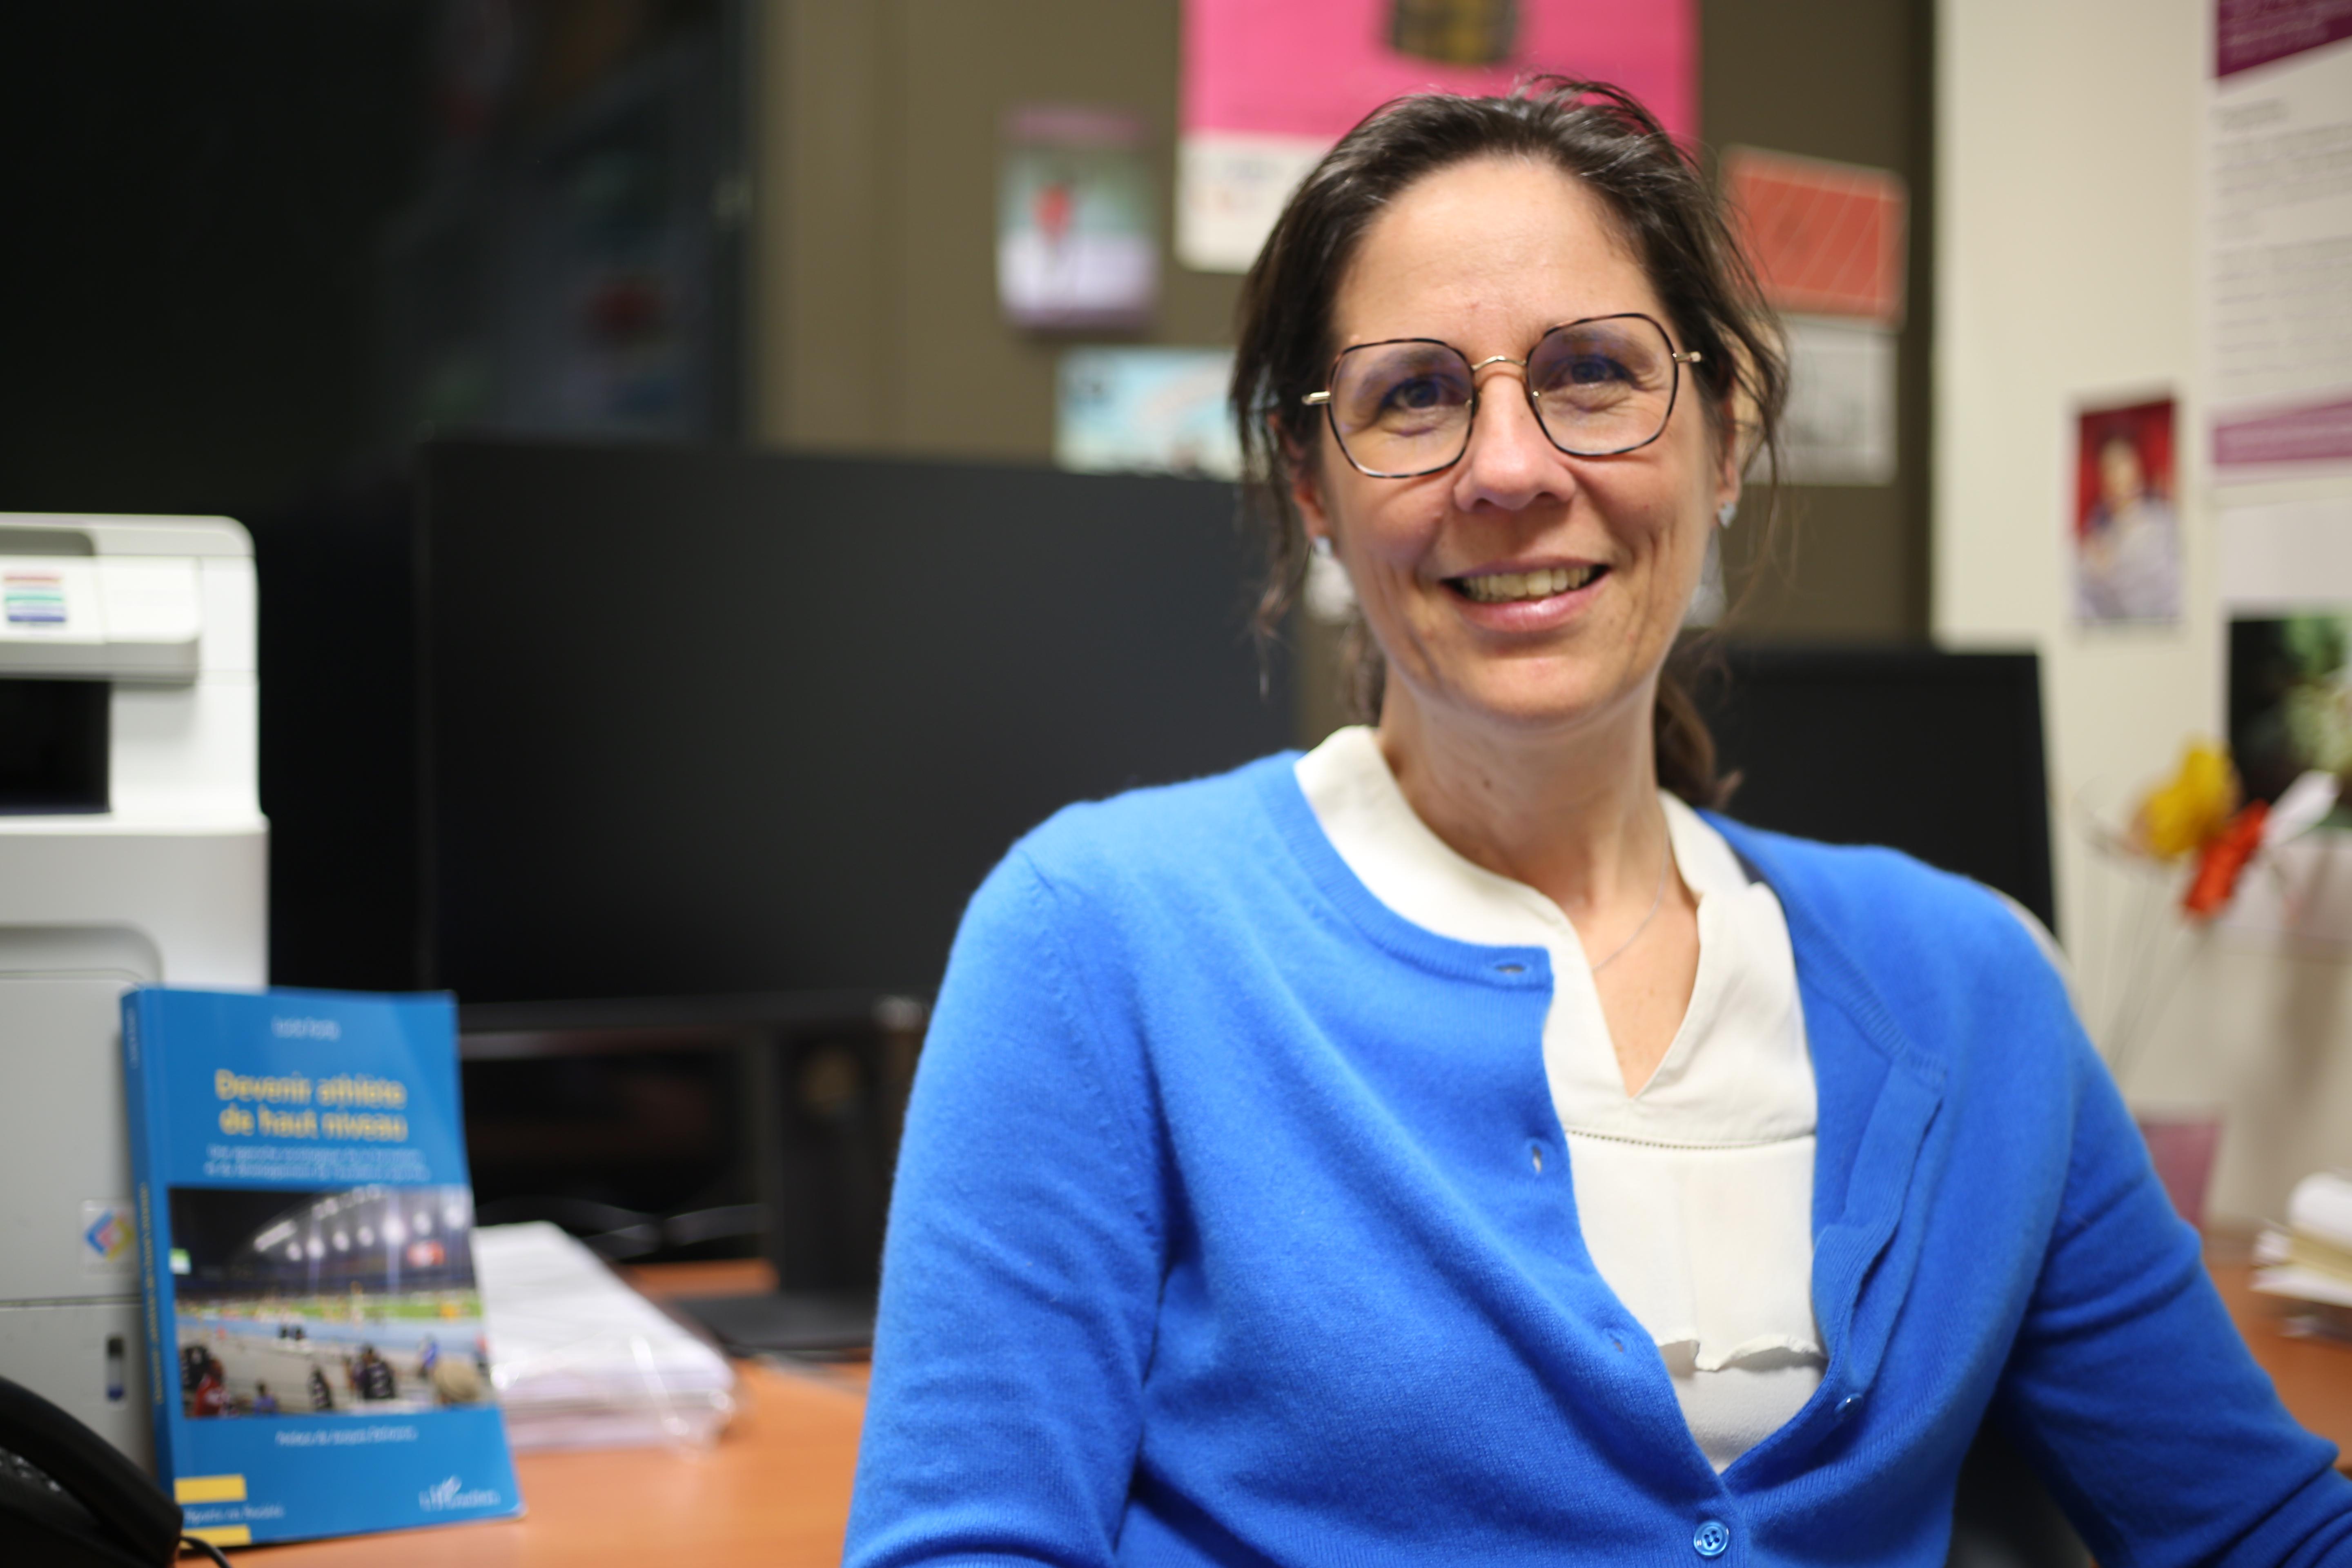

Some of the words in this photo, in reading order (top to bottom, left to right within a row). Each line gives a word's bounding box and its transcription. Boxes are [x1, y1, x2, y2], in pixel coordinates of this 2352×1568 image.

[216, 1069, 312, 1104] Devenir
[219, 1103, 254, 1135] de
[258, 1104, 318, 1138] haut
[322, 1108, 408, 1141] niveau
